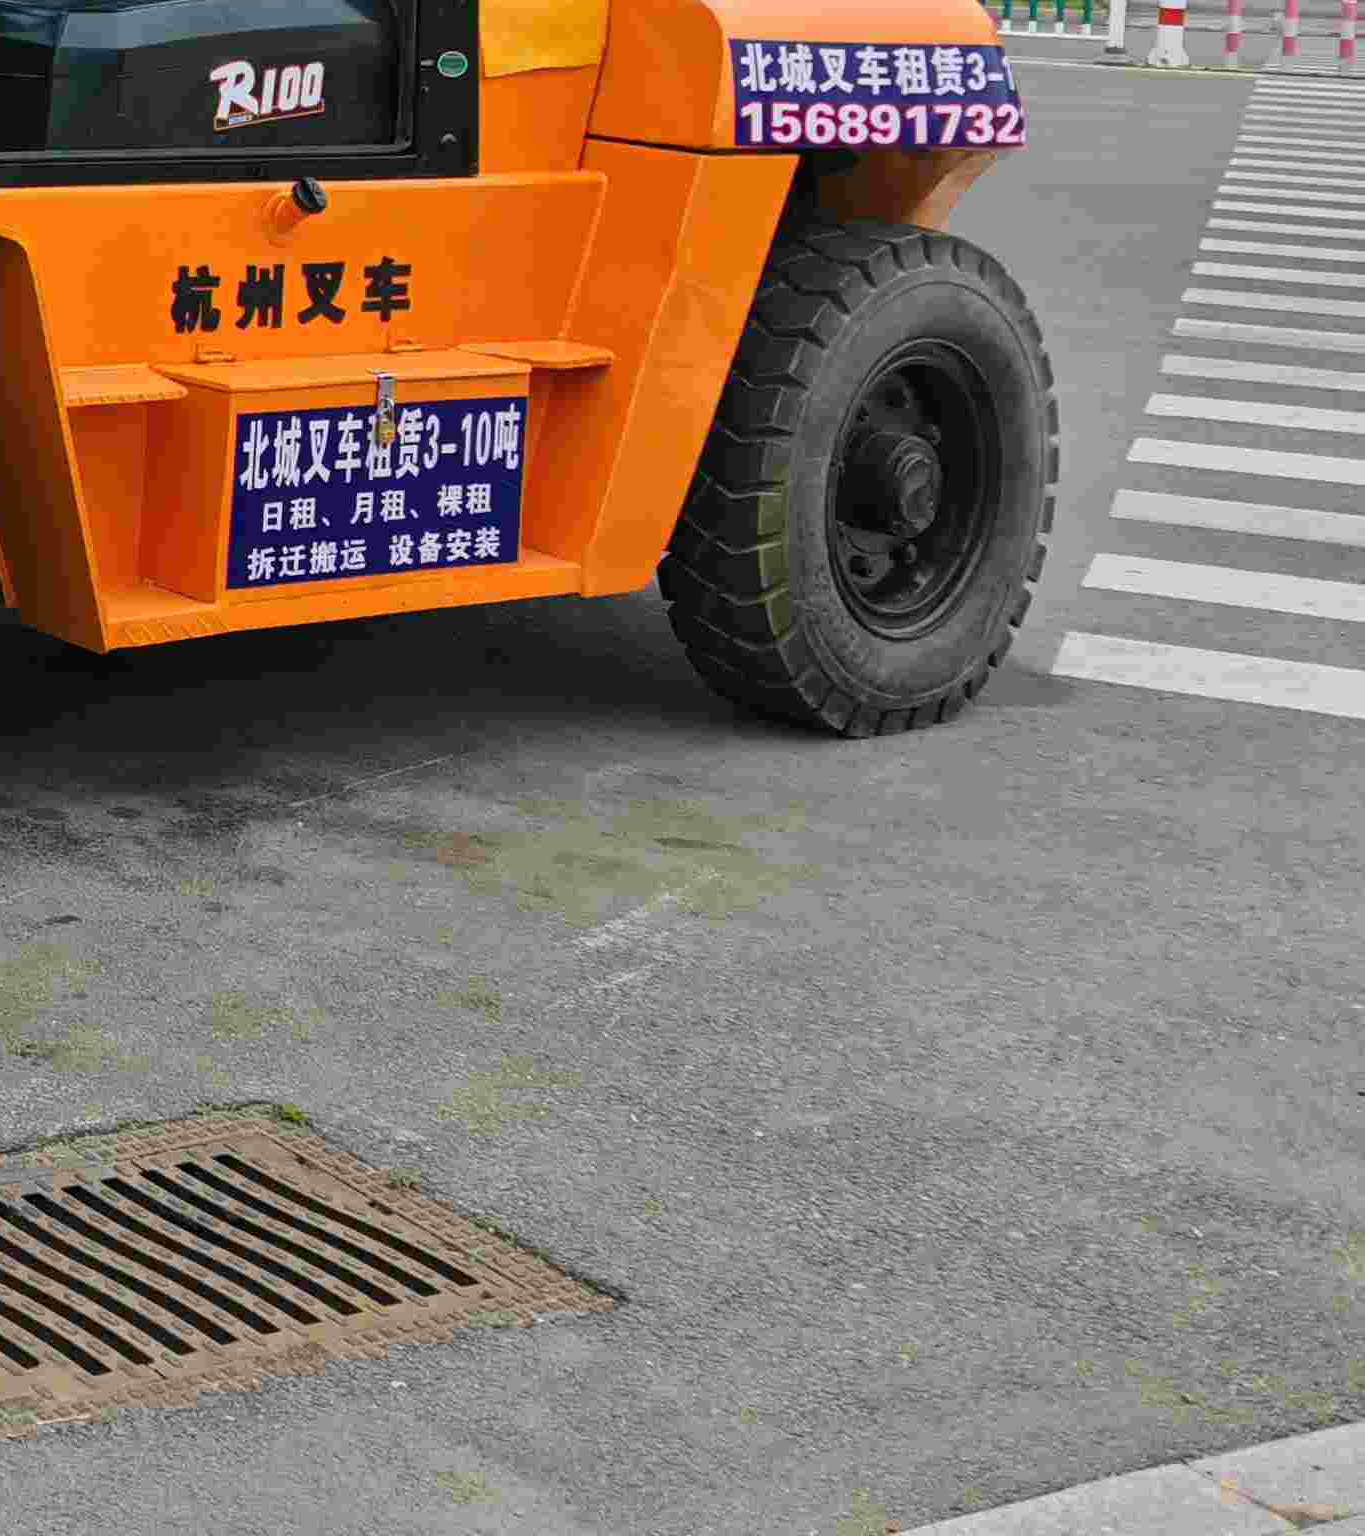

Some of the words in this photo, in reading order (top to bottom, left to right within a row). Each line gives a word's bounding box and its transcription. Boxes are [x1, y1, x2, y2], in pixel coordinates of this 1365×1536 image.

[209, 60, 325, 120] R100
[740, 101, 1027, 145] 156891732
[171, 257, 413, 334] 杭州叉车
[246, 538, 368, 581] 拆迁搬运
[388, 526, 502, 566] 设备安装
